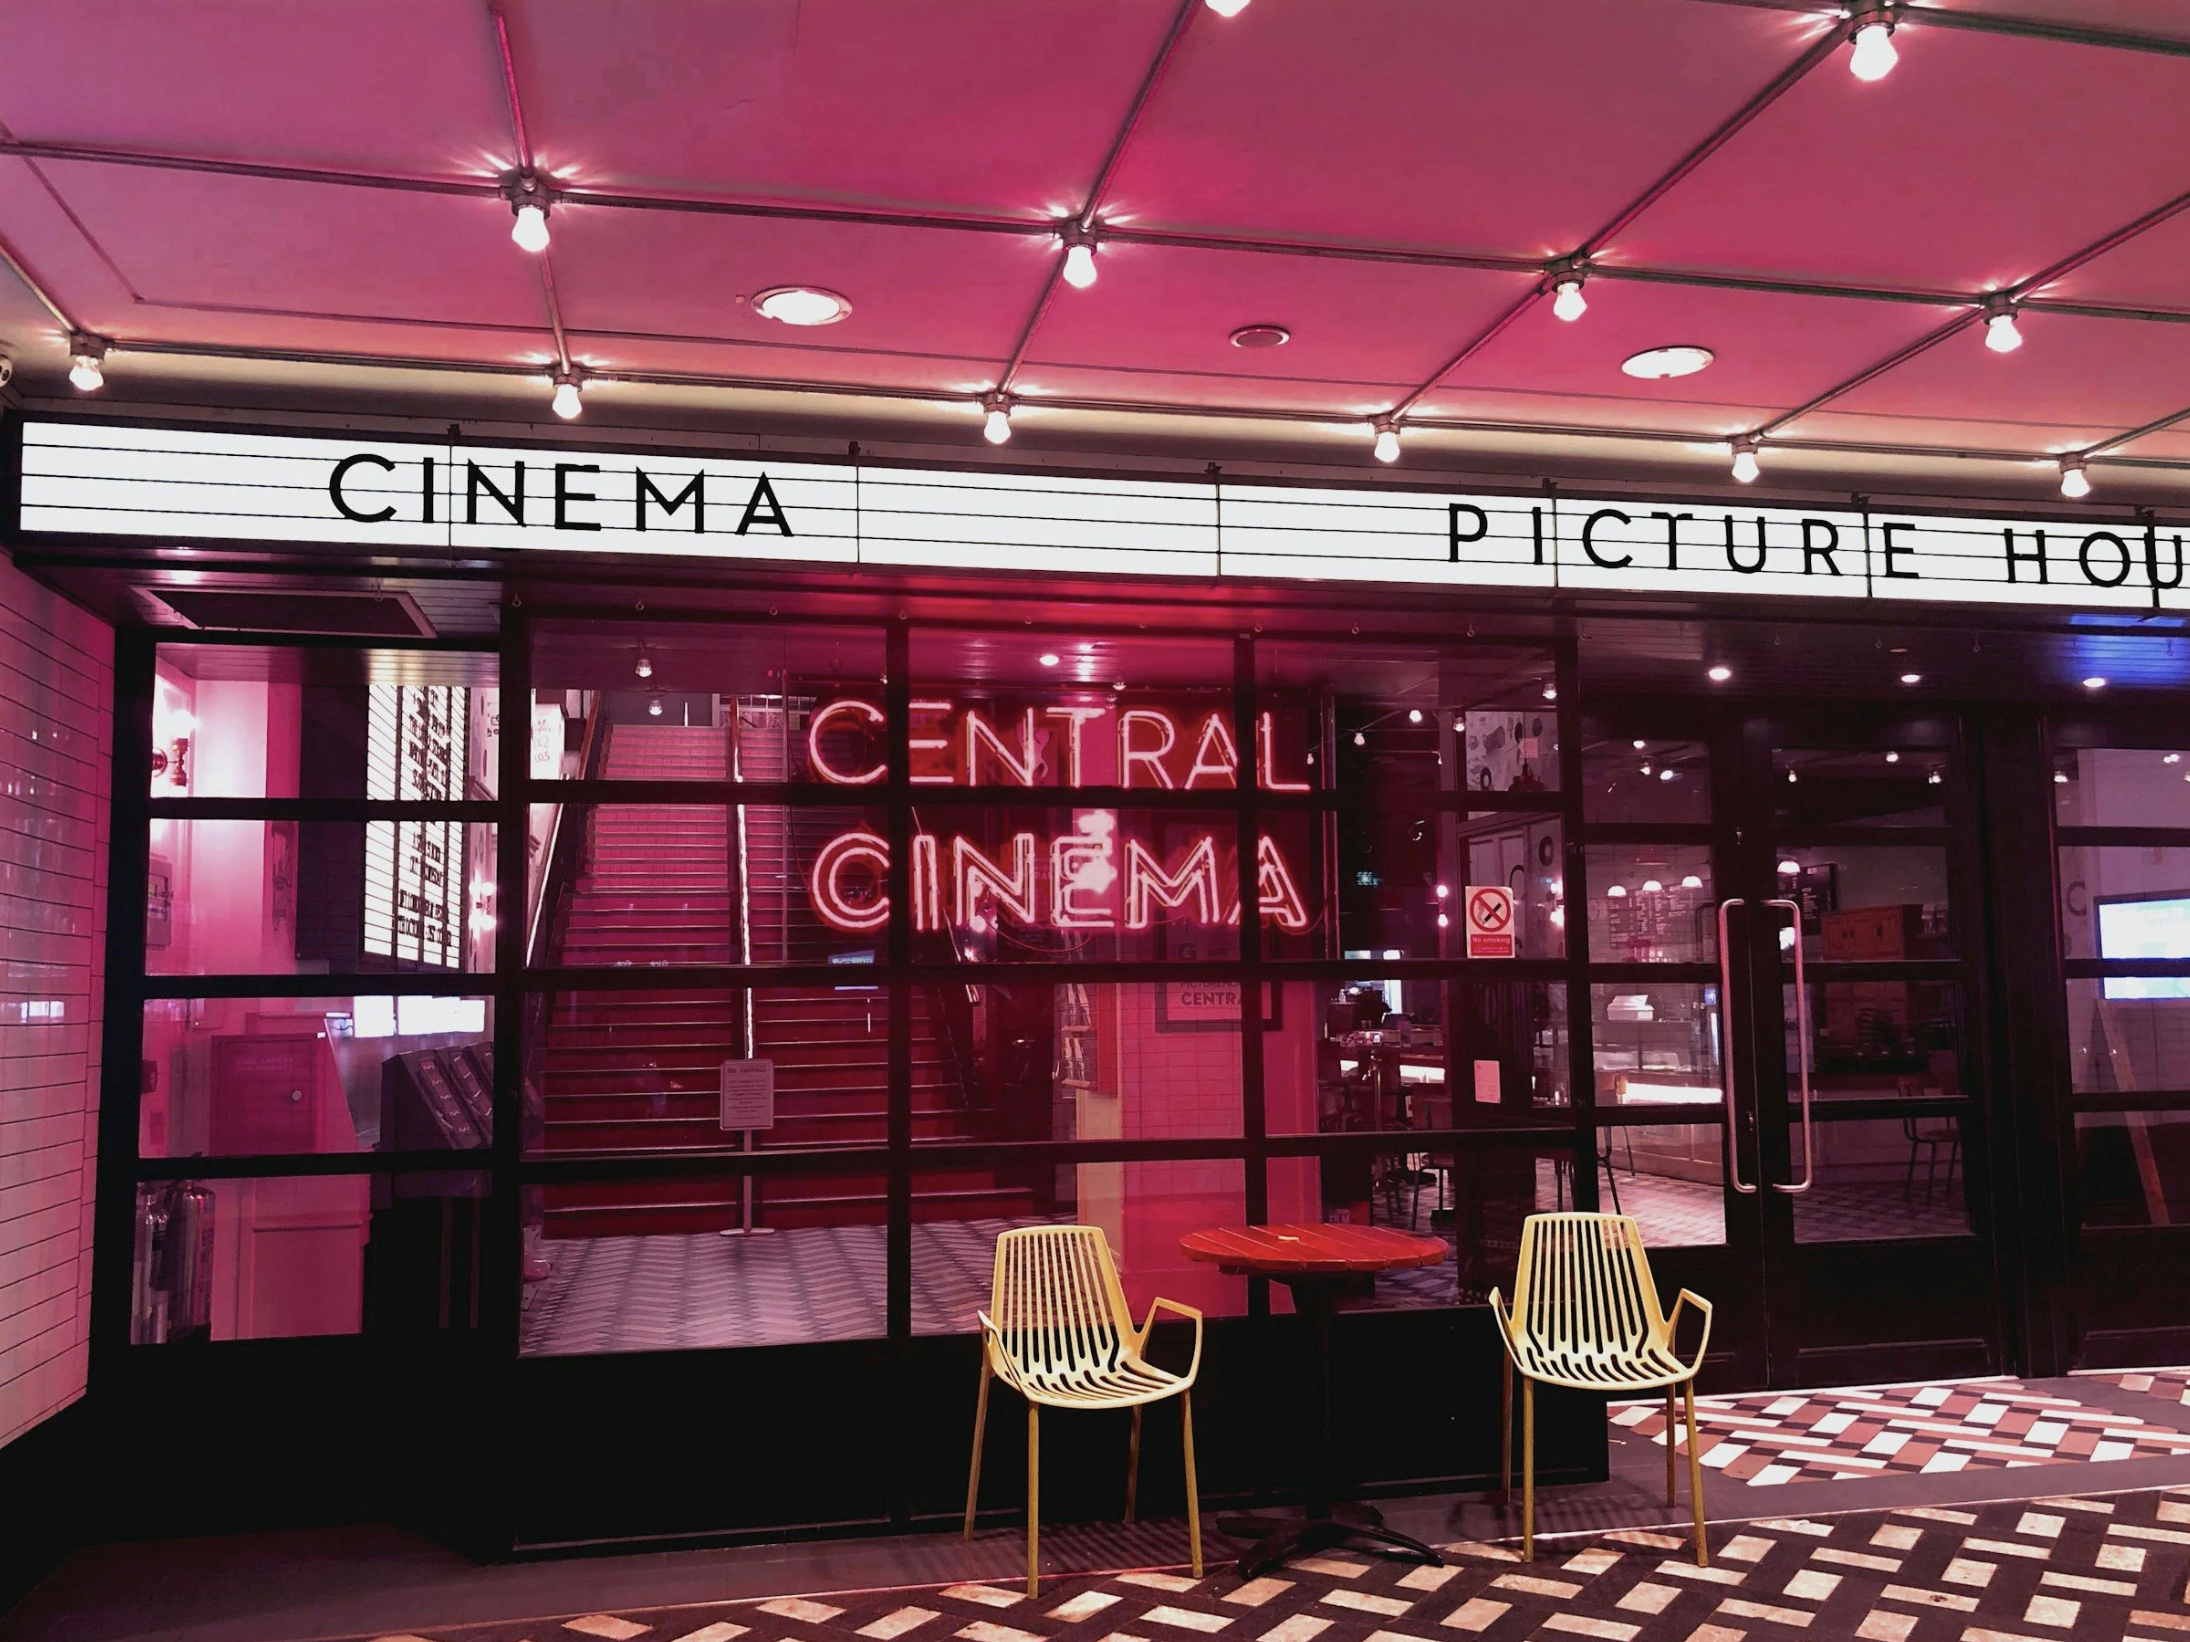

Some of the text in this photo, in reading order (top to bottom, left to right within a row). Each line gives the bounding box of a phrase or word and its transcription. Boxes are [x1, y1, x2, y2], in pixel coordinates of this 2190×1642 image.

[329, 453, 794, 536] CINEMA
[1449, 503, 2183, 589] PICTURE HOU
[809, 700, 1310, 791] CENTRAL
[813, 831, 1307, 932] CINEMA
[1483, 936, 1511, 944] smoking
